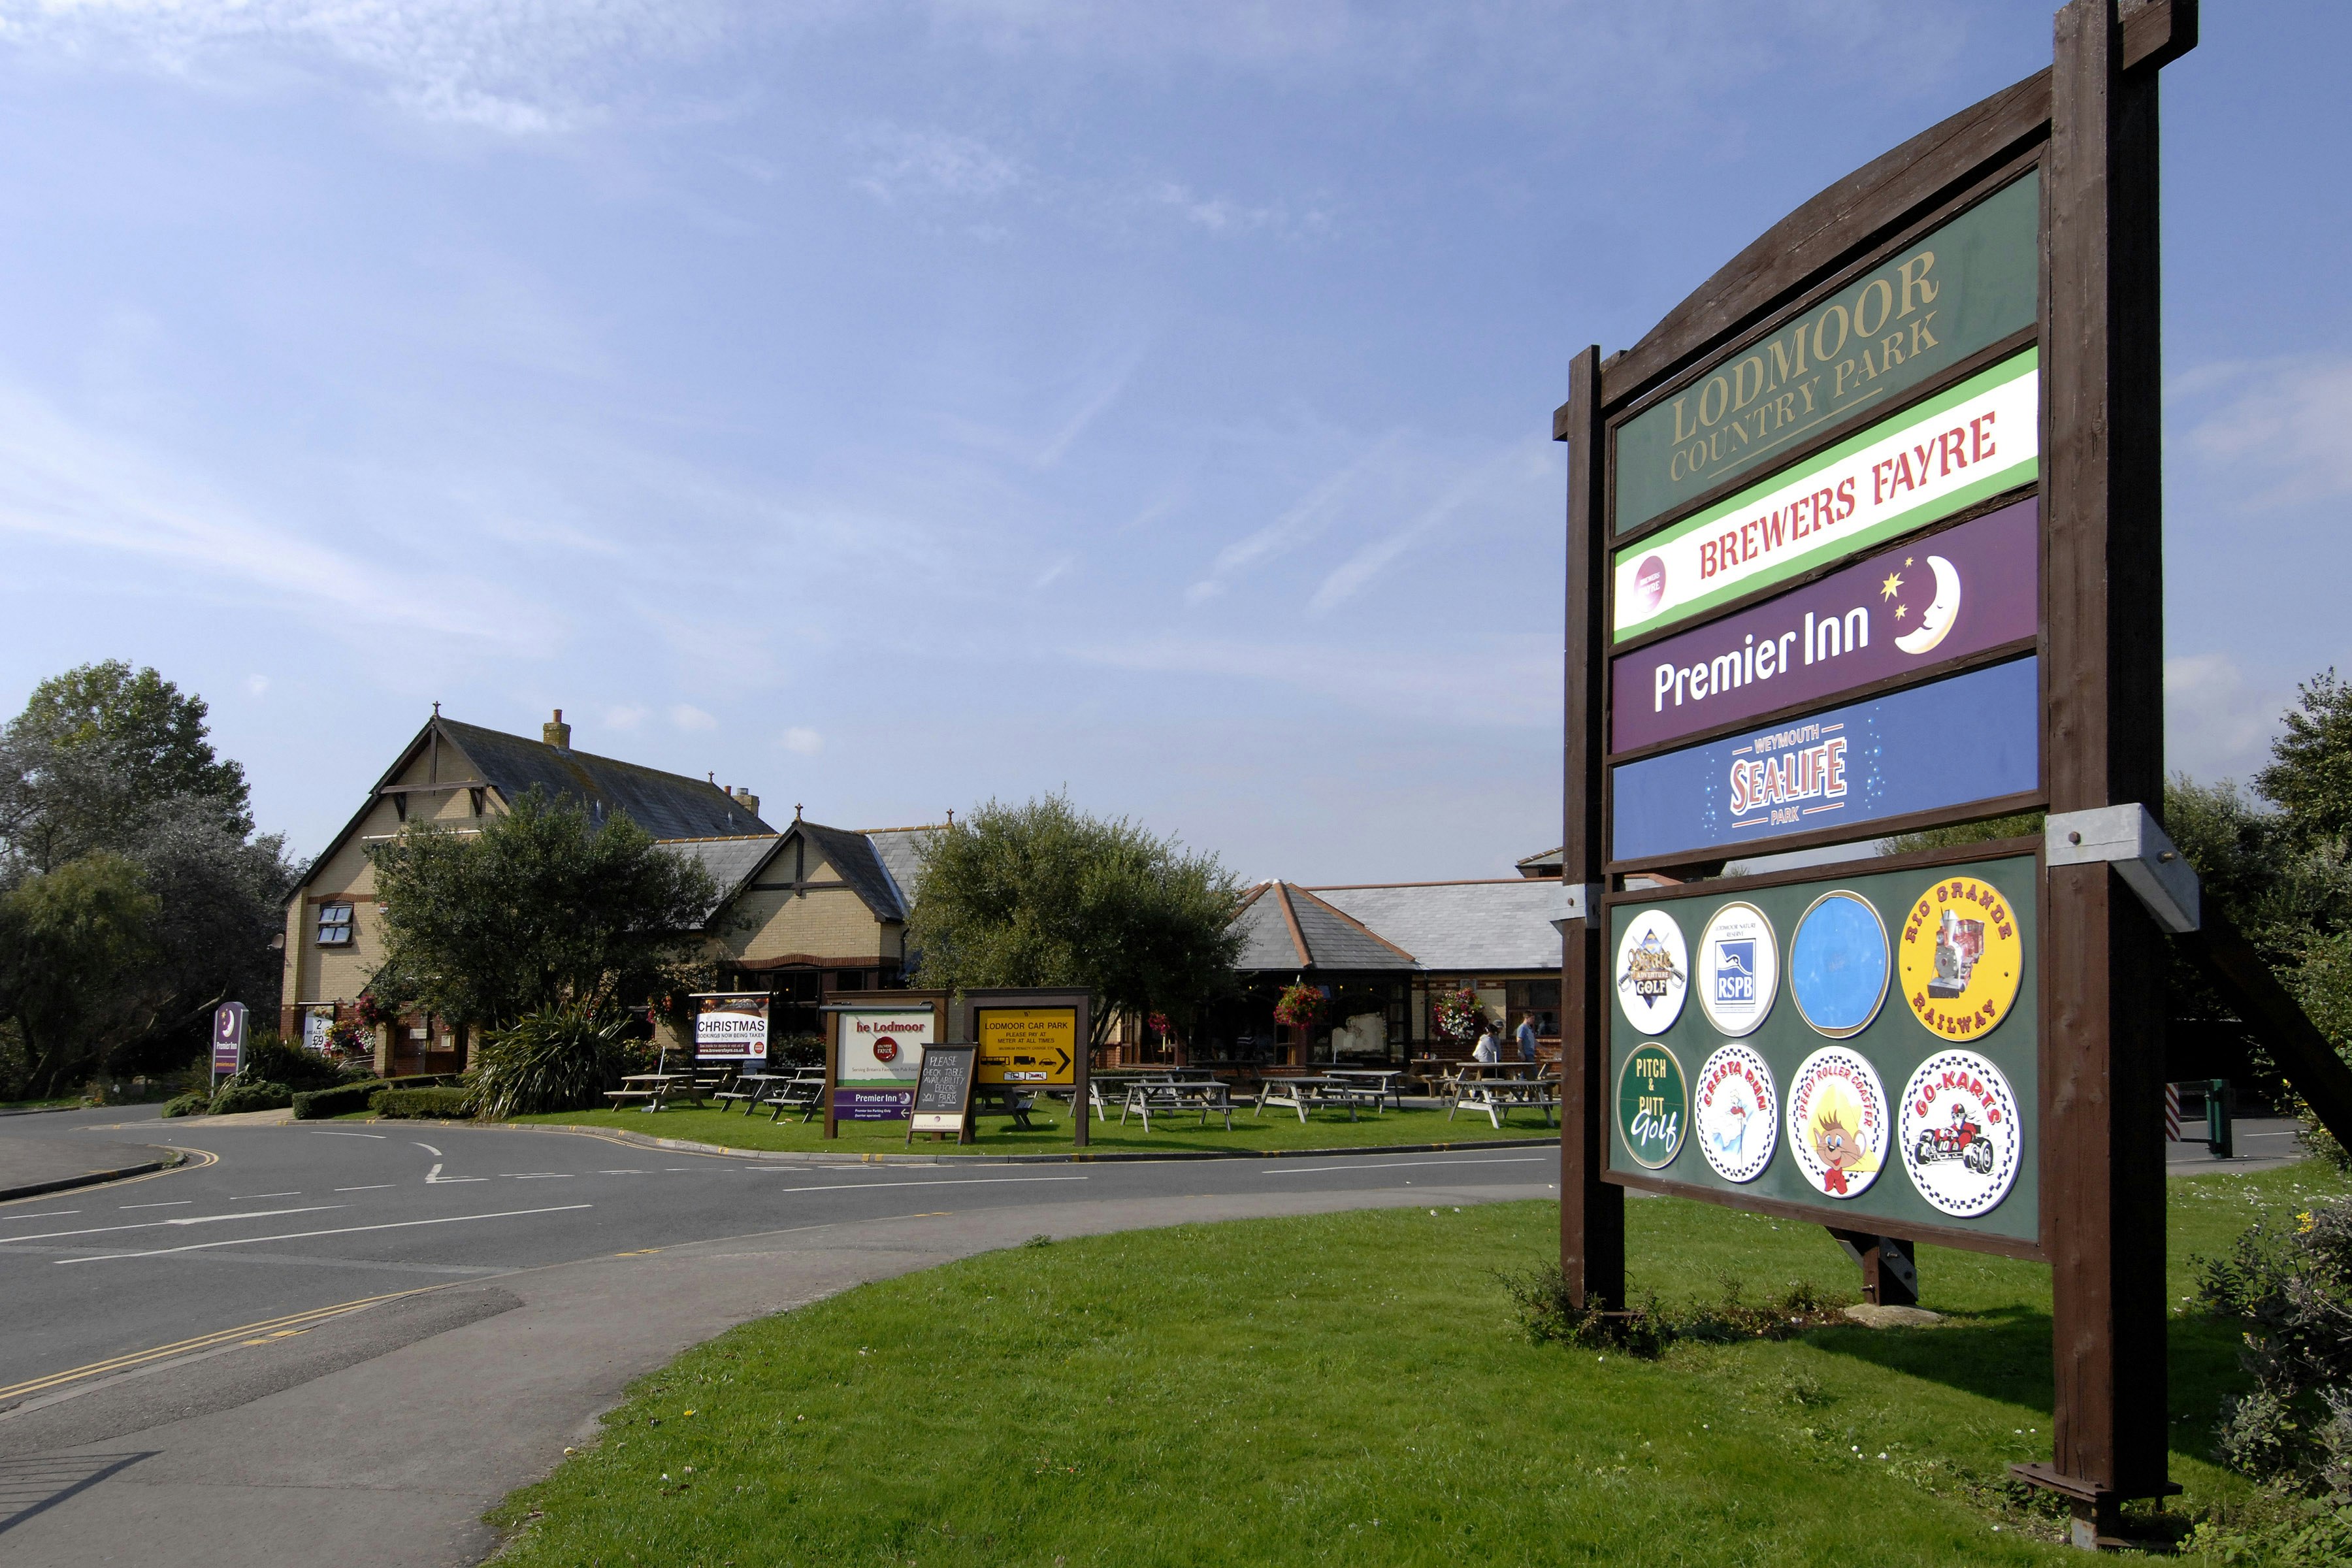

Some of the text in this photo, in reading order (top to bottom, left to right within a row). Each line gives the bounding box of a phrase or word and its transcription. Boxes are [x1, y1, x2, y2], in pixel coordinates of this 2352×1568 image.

[1671, 251, 1939, 446] LODMOOR
[1671, 311, 1939, 482] COUNTRY PARK
[1700, 411, 1996, 580] BREWERS FAYRE
[1654, 606, 1869, 713] Premier Inn
[1754, 723, 1820, 754] WEYMOUTH
[1771, 806, 1800, 826] PARK
[1905, 882, 2012, 943] RIO GRANDE
[1636, 980, 1667, 995] GOLF
[1718, 976, 1753, 998] RSPB
[1913, 992, 1995, 1034] RAILWAY
[317, 1020, 322, 1030] 2
[698, 1021, 765, 1032] CHRISTMAS
[874, 1021, 925, 1033] Lodmoor
[312, 1036, 324, 1046] £9
[930, 1056, 958, 1066] PLEASE
[1636, 1058, 1667, 1078] PITCH
[923, 1076, 966, 1085] AVAILABILITY
[945, 1068, 964, 1077] TABLE
[935, 1084, 958, 1092] BEFORE
[1648, 1078, 1654, 1091] &
[1704, 1061, 1767, 1111] CRESTA RUN
[855, 1094, 897, 1102] Premier Inn
[938, 1094, 957, 1102] PARK
[1639, 1096, 1664, 1117] PUTT
[1799, 1066, 1873, 1128] SPEEDY ROLLER COASTER
[1915, 1071, 2001, 1125] GO-KARTS
